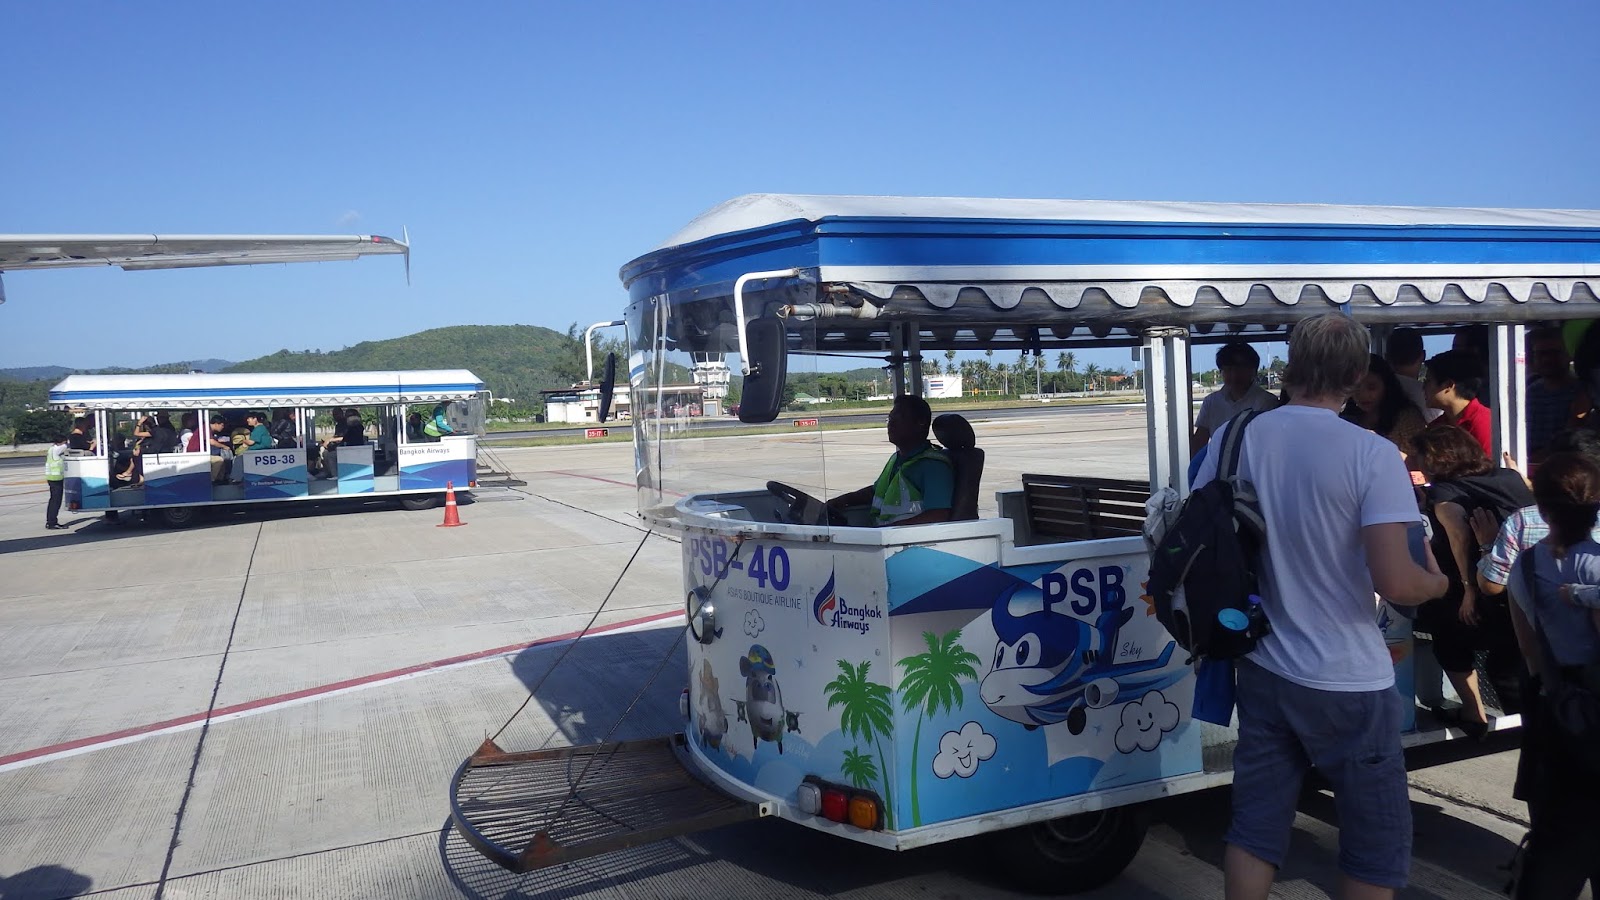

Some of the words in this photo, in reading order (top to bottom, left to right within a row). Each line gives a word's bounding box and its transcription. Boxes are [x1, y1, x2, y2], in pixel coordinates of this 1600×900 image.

[255, 454, 295, 466] PSB-38
[743, 590, 773, 605] BOUTIQUE
[774, 596, 802, 609] AIRLINE
[1042, 566, 1125, 618] PSB
[839, 596, 882, 621] Bangkok
[831, 610, 869, 635] Airways
[1120, 642, 1142, 660] Sky
